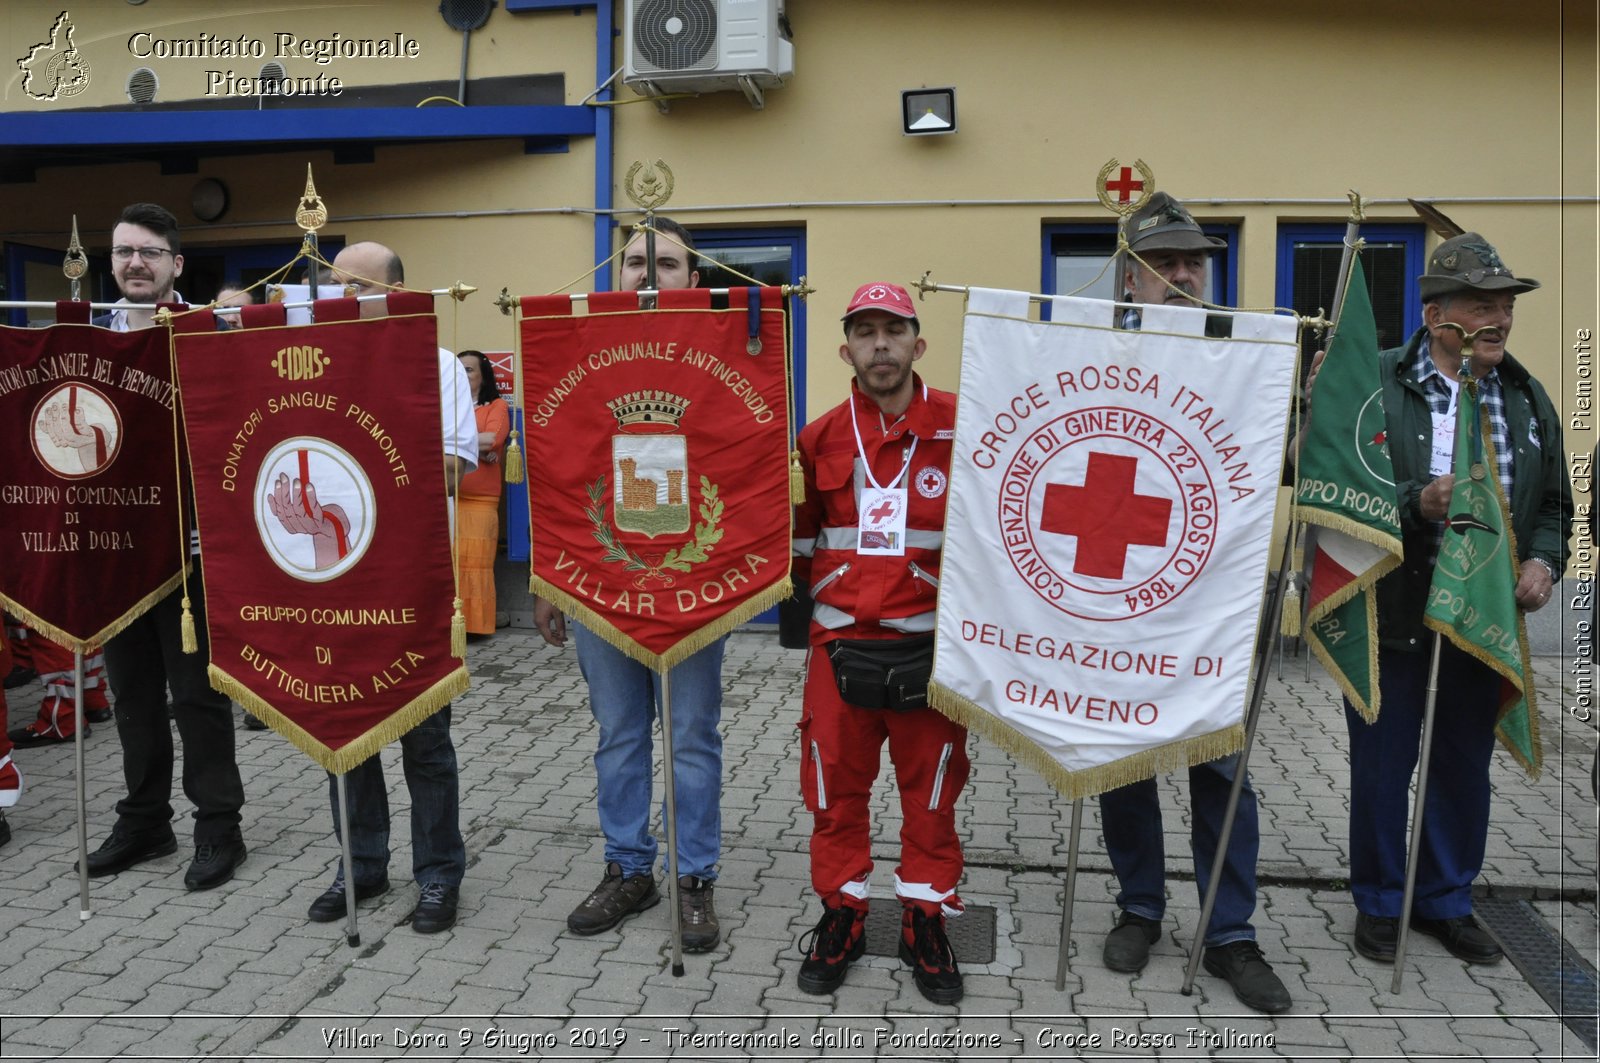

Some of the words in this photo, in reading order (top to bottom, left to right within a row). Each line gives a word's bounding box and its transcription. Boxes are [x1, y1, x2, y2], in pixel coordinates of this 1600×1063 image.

[26, 369, 39, 385] DI
[39, 353, 89, 382] SANGUE
[92, 357, 115, 386] DEL
[118, 366, 180, 410] PIEMONTE
[532, 366, 587, 428] SQUADRA
[588, 342, 678, 371] COMUNALE
[681, 347, 775, 424] ANTINCENDIO
[222, 408, 263, 492] DONATORI
[268, 392, 339, 414] SANGUE
[345, 404, 410, 488] PIEMONTE
[972, 383, 1050, 471] CROCE
[1056, 365, 1161, 399] ROSSA
[1170, 386, 1256, 503] ITALIANA
[1033, 428, 1061, 454] DI
[1064, 411, 1166, 449] GINEVRA
[1167, 445, 1198, 474] 22
[2, 485, 60, 504] GRUPPO
[65, 485, 161, 505] COMUNALE
[65, 512, 80, 525] DI
[21, 532, 79, 552] VILLAR
[89, 530, 134, 550] DORA
[1003, 451, 1065, 600] CONVENZIONE
[1173, 480, 1213, 577] AGOSTO
[555, 550, 655, 616] VILLAR
[675, 553, 769, 613] DORA
[1125, 577, 1176, 613] 1864
[240, 606, 307, 624] GRUPPO
[311, 608, 417, 626] COMUNALE
[315, 646, 332, 665] DI
[962, 620, 1179, 677] DELEGAZIONE
[1194, 656, 1223, 677] DI
[240, 644, 364, 703] BUTTIGLIERA
[372, 650, 425, 693] ALTA
[1005, 679, 1159, 726] GIAVENO
